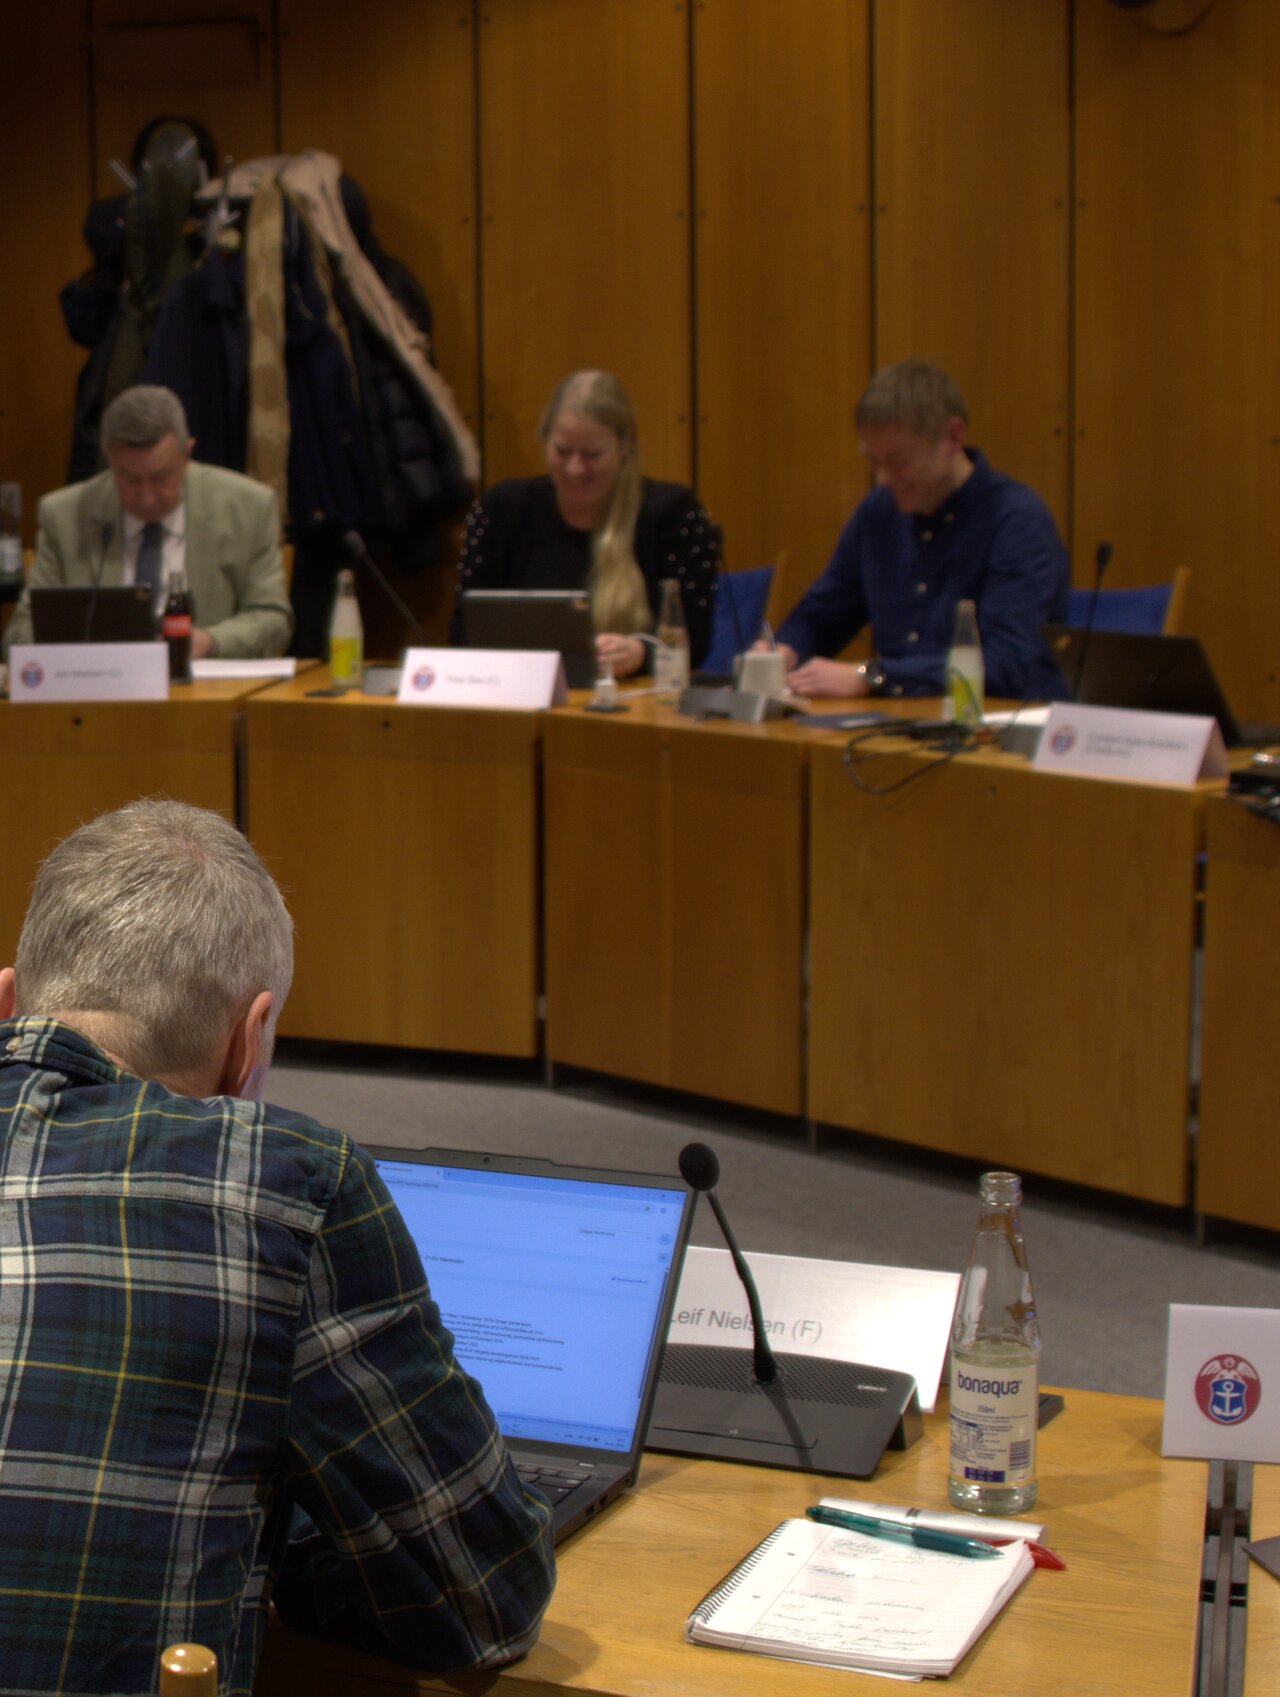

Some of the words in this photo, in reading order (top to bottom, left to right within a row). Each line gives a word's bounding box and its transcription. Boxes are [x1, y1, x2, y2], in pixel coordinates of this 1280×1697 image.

[670, 1308, 705, 1326] eif
[792, 1318, 824, 1344] (F)
[958, 1370, 1020, 1399] bonaqua
